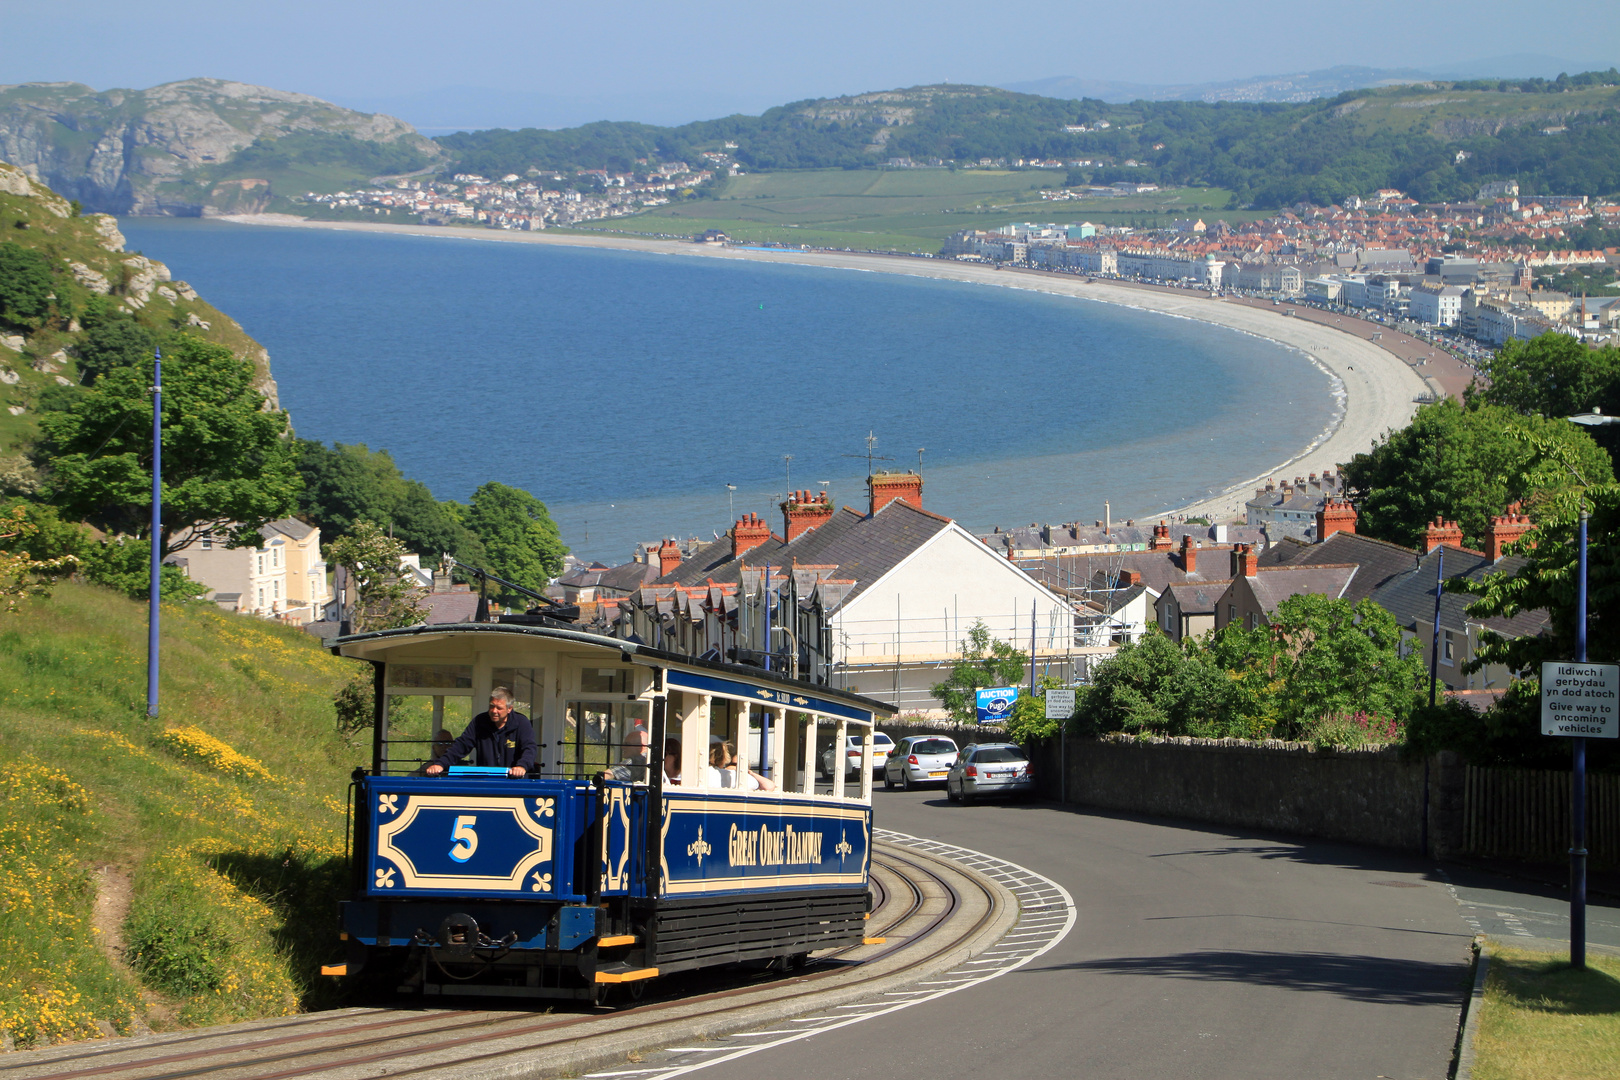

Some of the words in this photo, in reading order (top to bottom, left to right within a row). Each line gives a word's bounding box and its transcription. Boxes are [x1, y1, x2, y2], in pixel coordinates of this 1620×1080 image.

[1558, 666, 1597, 677] Ildiwch
[1599, 668, 1603, 677] i
[1555, 678, 1606, 688] gerbydau
[979, 689, 1015, 699] AUCTION
[1546, 689, 1559, 697] yn
[1562, 688, 1582, 697] dod
[1584, 689, 1615, 698] atoch
[989, 701, 1006, 711] Pugh
[1549, 701, 1573, 711] Give
[1576, 704, 1597, 714] way
[1600, 704, 1612, 713] to
[1554, 714, 1606, 724] oncoming
[1558, 724, 1602, 733] vehicles
[449, 815, 478, 862] 5
[728, 822, 758, 867] GREAT
[759, 823, 785, 866] ORME
[785, 824, 823, 865] TRAMWAY
